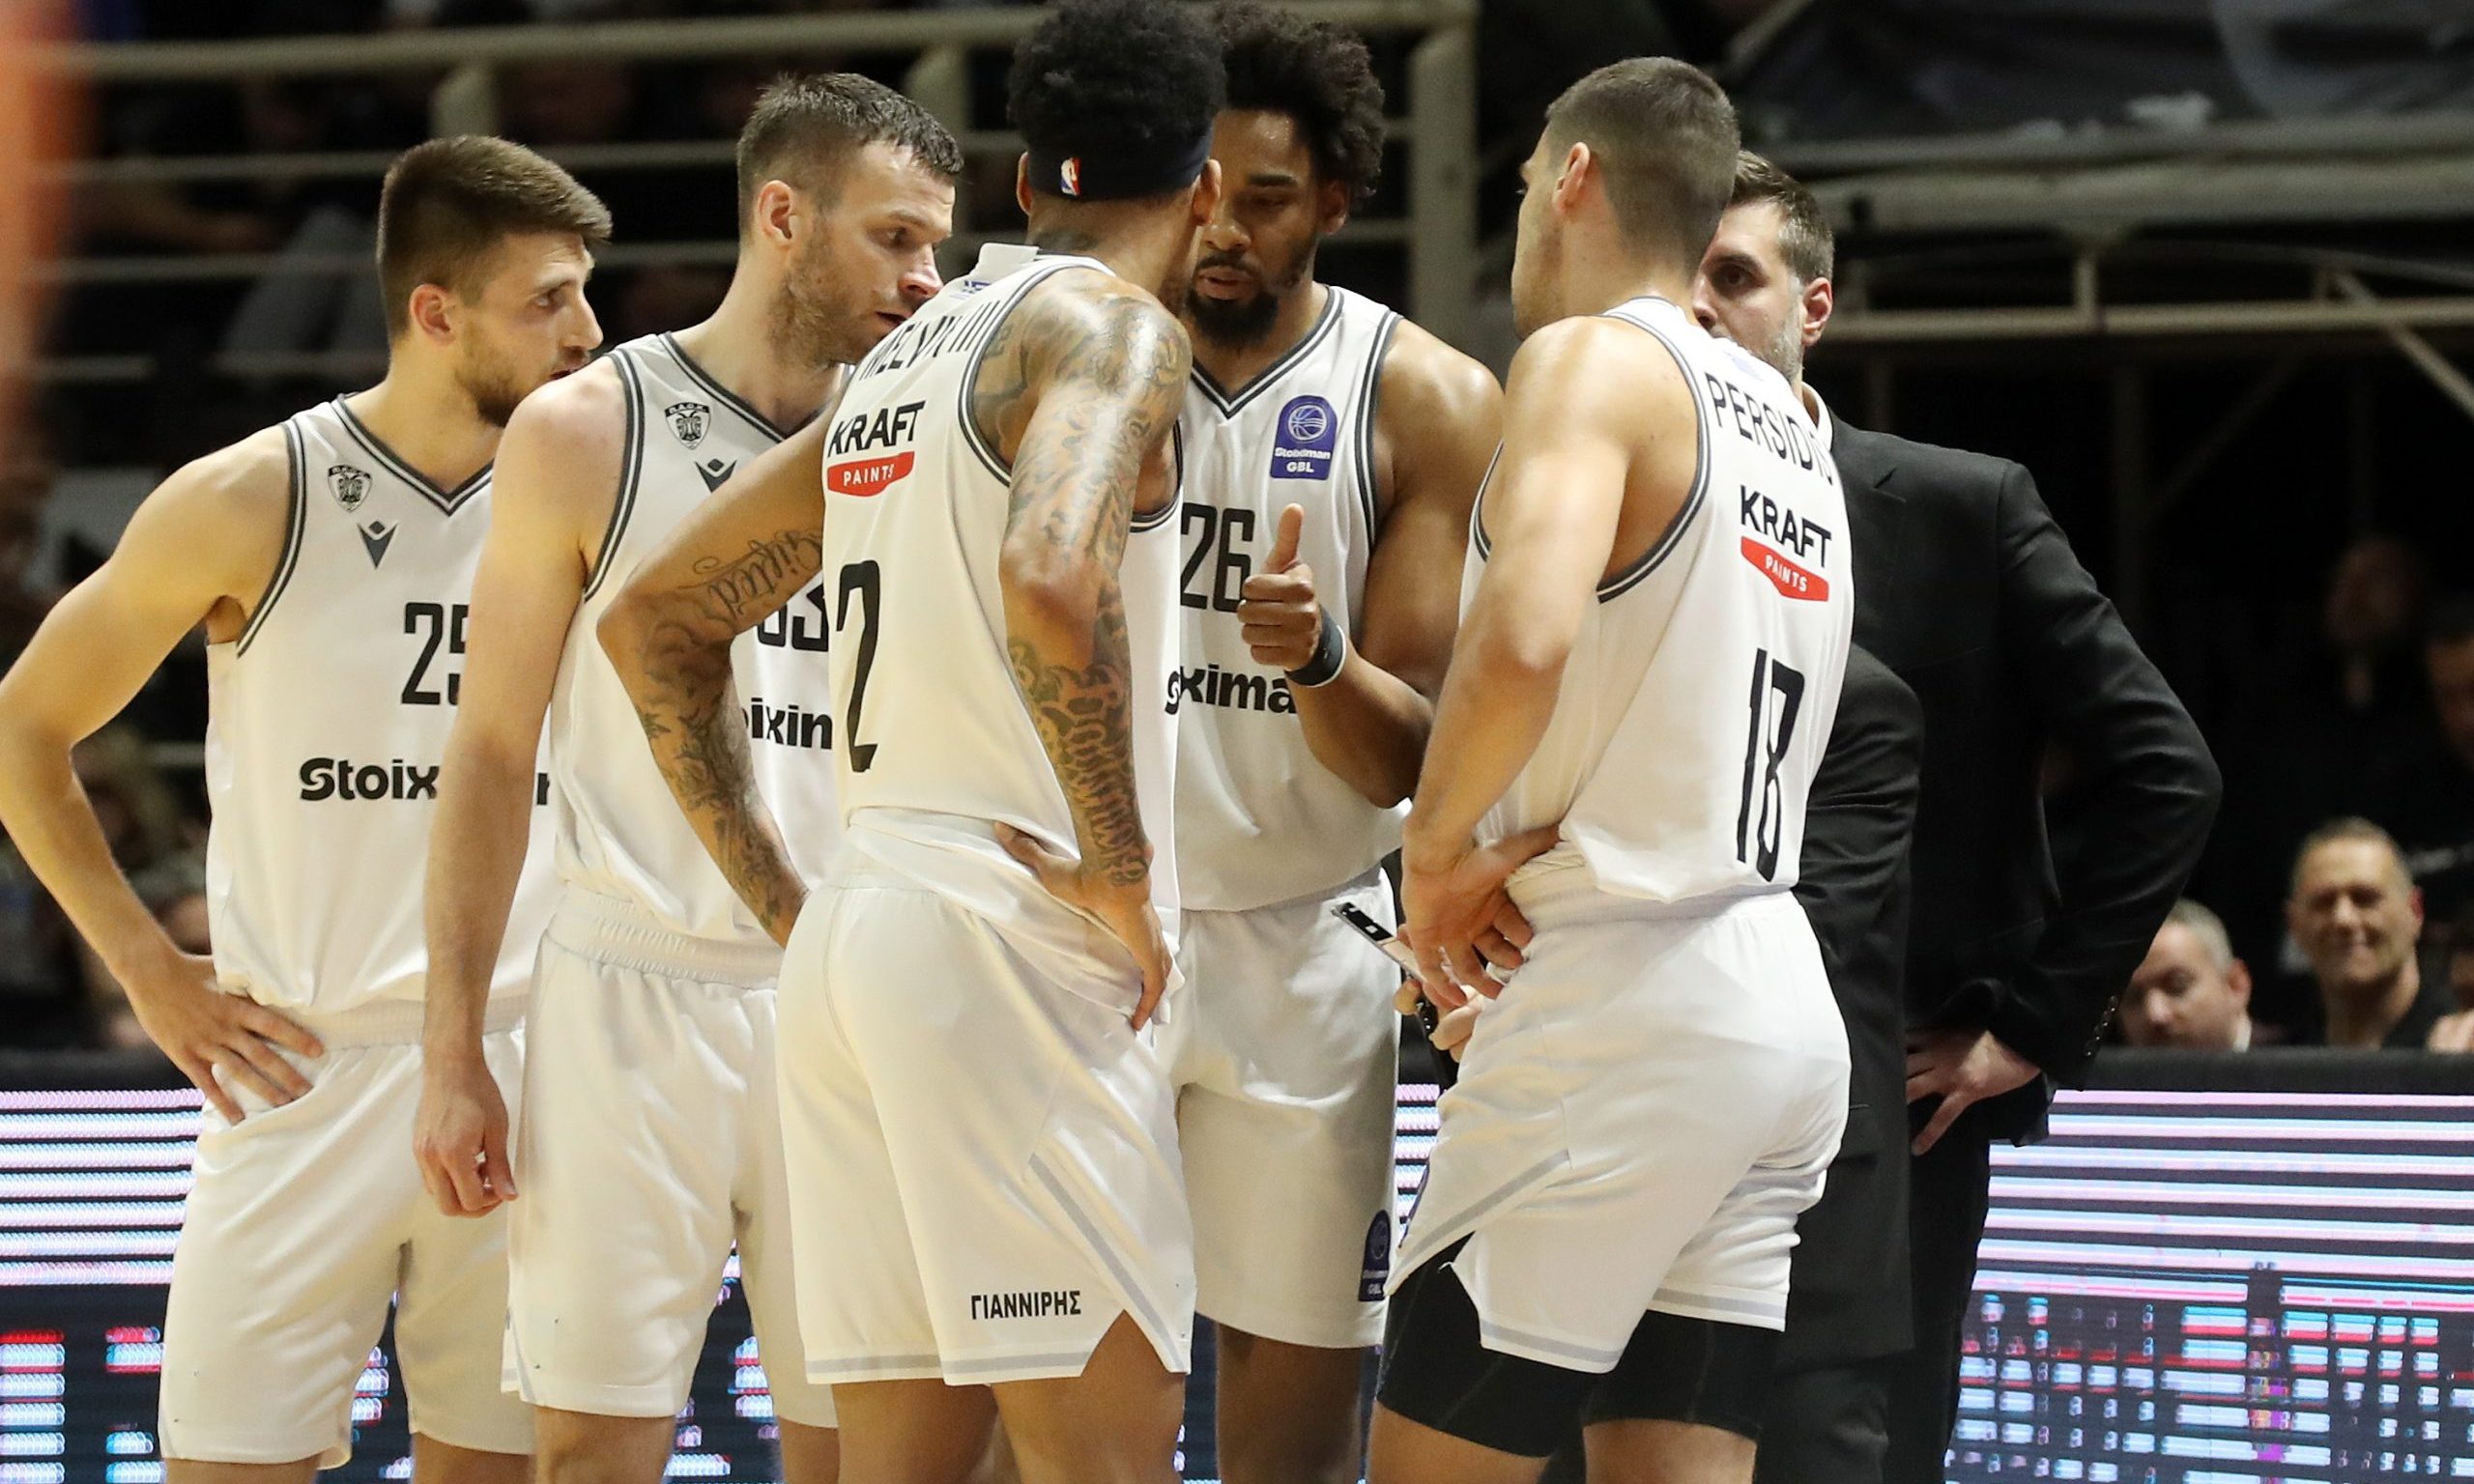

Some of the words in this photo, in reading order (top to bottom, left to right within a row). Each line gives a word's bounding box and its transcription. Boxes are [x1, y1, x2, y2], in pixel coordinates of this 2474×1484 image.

[827, 400, 926, 458] KRAFT
[843, 464, 895, 487] PAINTS
[1286, 461, 1314, 472] GBL
[1740, 485, 1832, 568] KRAFT
[1180, 501, 1255, 614] 26
[1765, 555, 1808, 593] PAINTS
[1737, 647, 1805, 883] 18
[970, 1290, 1081, 1320] ΓΙΑΝΝΙΡΗΣ
